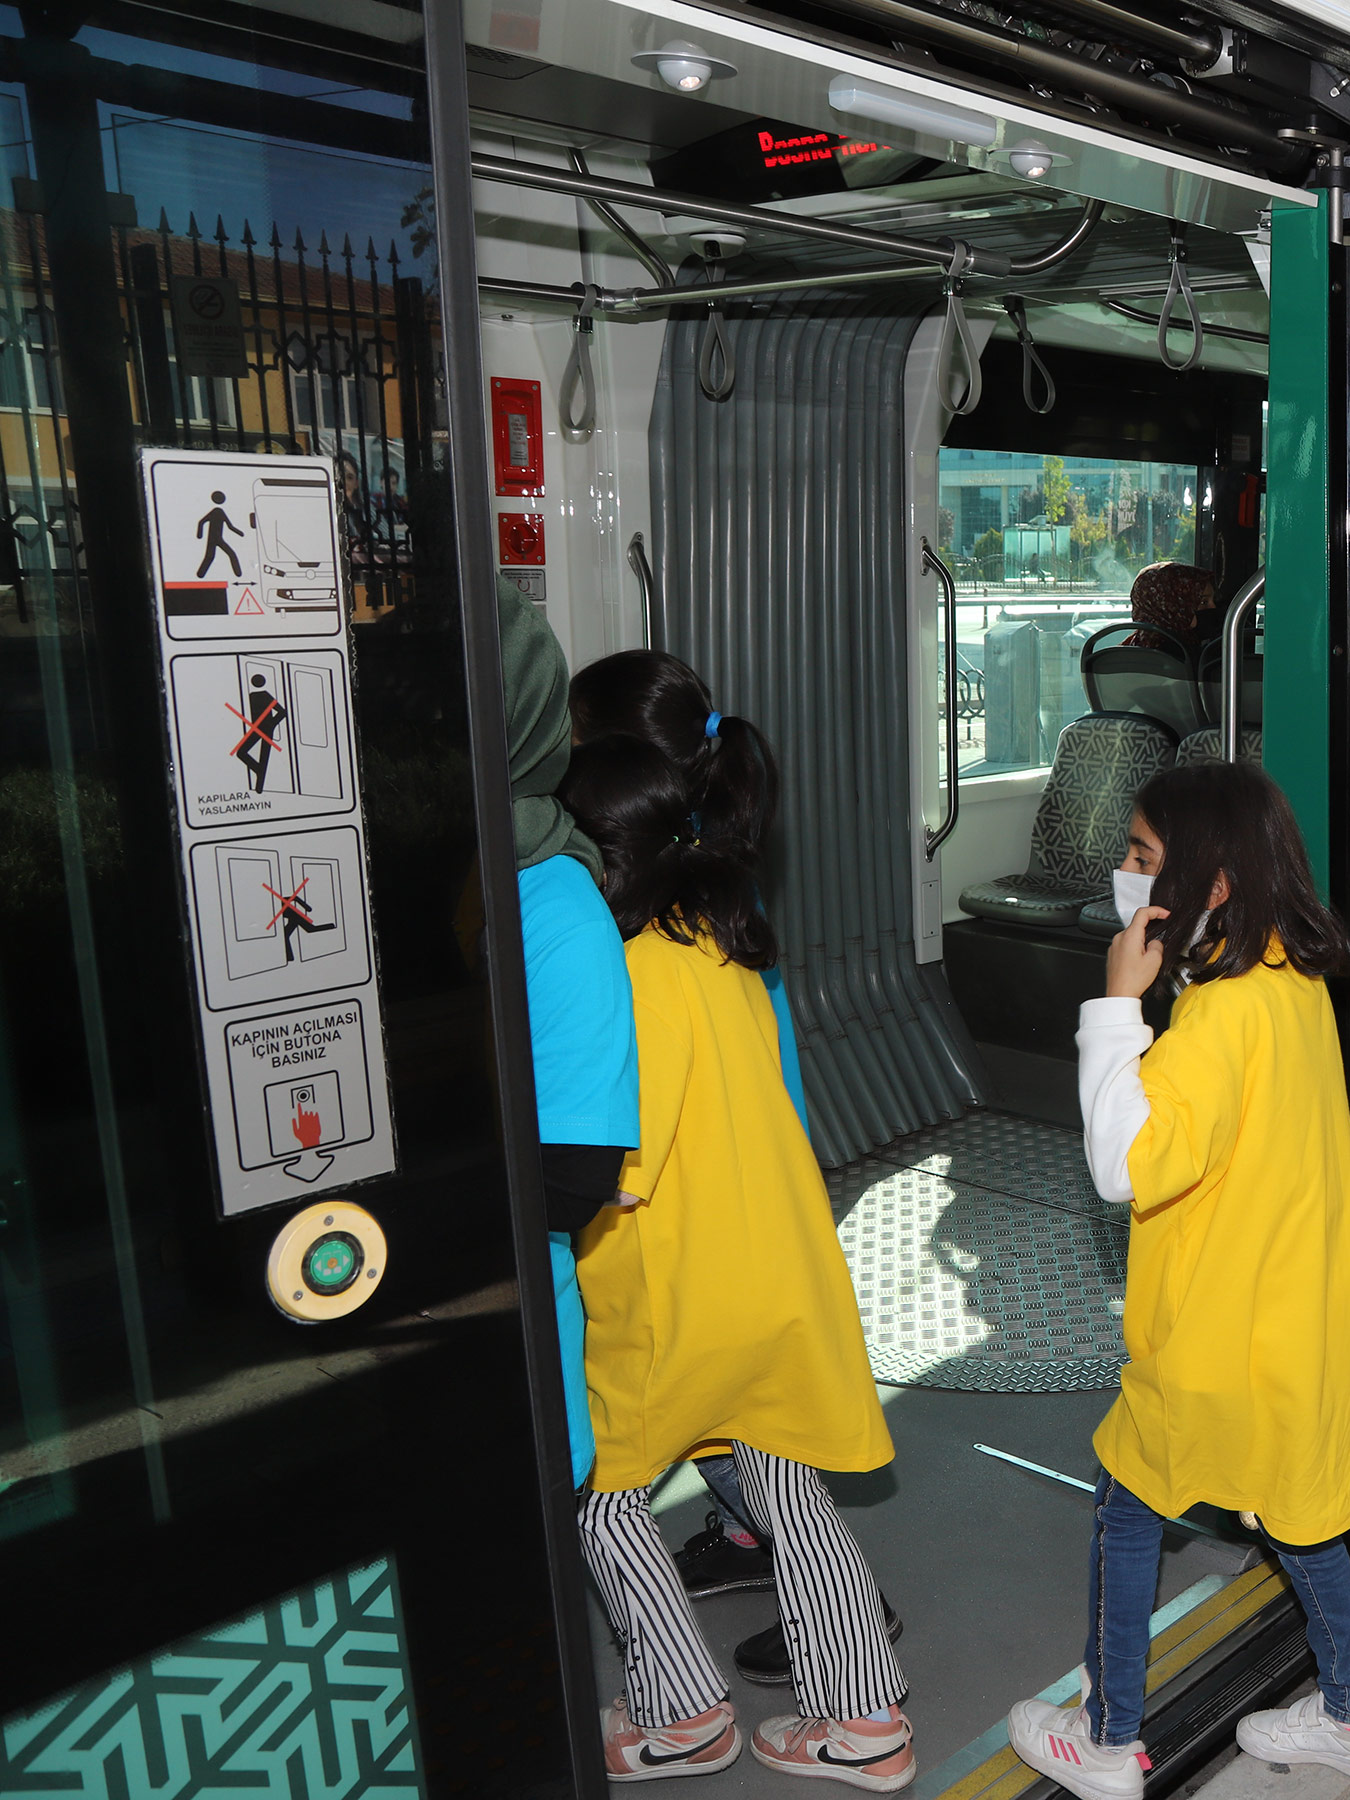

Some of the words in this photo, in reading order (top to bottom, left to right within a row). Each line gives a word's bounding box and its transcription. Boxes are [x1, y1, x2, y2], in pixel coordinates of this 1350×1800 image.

[198, 791, 251, 804] KAPILARA
[198, 801, 272, 816] YASLANMAYIN
[231, 1025, 289, 1047] KAPININ
[293, 1012, 358, 1036] AÇILMASI
[252, 1041, 280, 1059] İÇİN
[284, 1029, 342, 1051] BUTONA
[272, 1047, 327, 1068] BASINIZ
